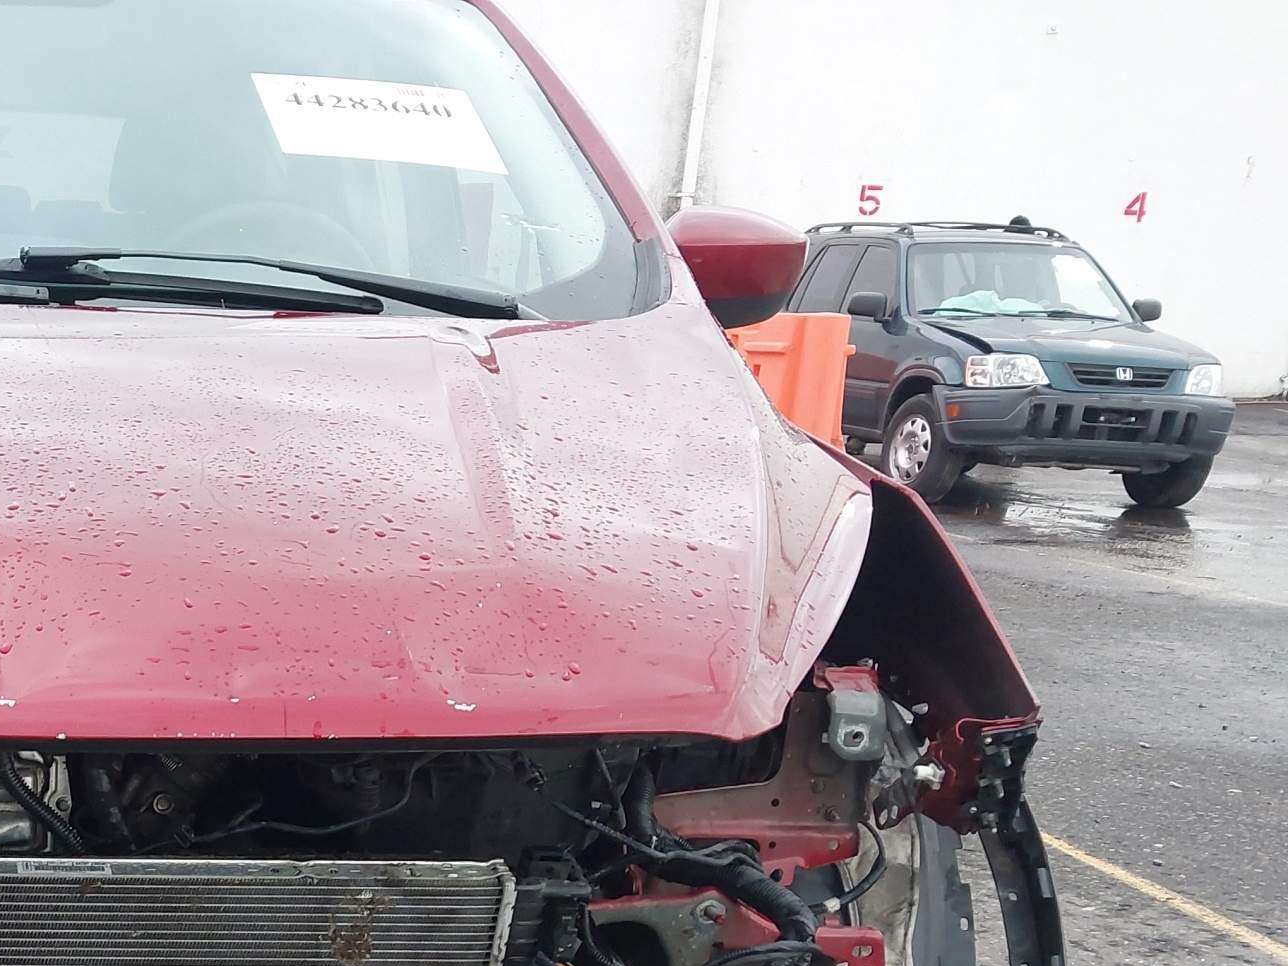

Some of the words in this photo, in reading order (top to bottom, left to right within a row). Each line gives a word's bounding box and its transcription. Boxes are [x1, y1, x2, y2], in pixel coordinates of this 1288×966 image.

[285, 91, 453, 118] 44283640
[857, 184, 884, 216] 5
[1123, 191, 1149, 222] 4
